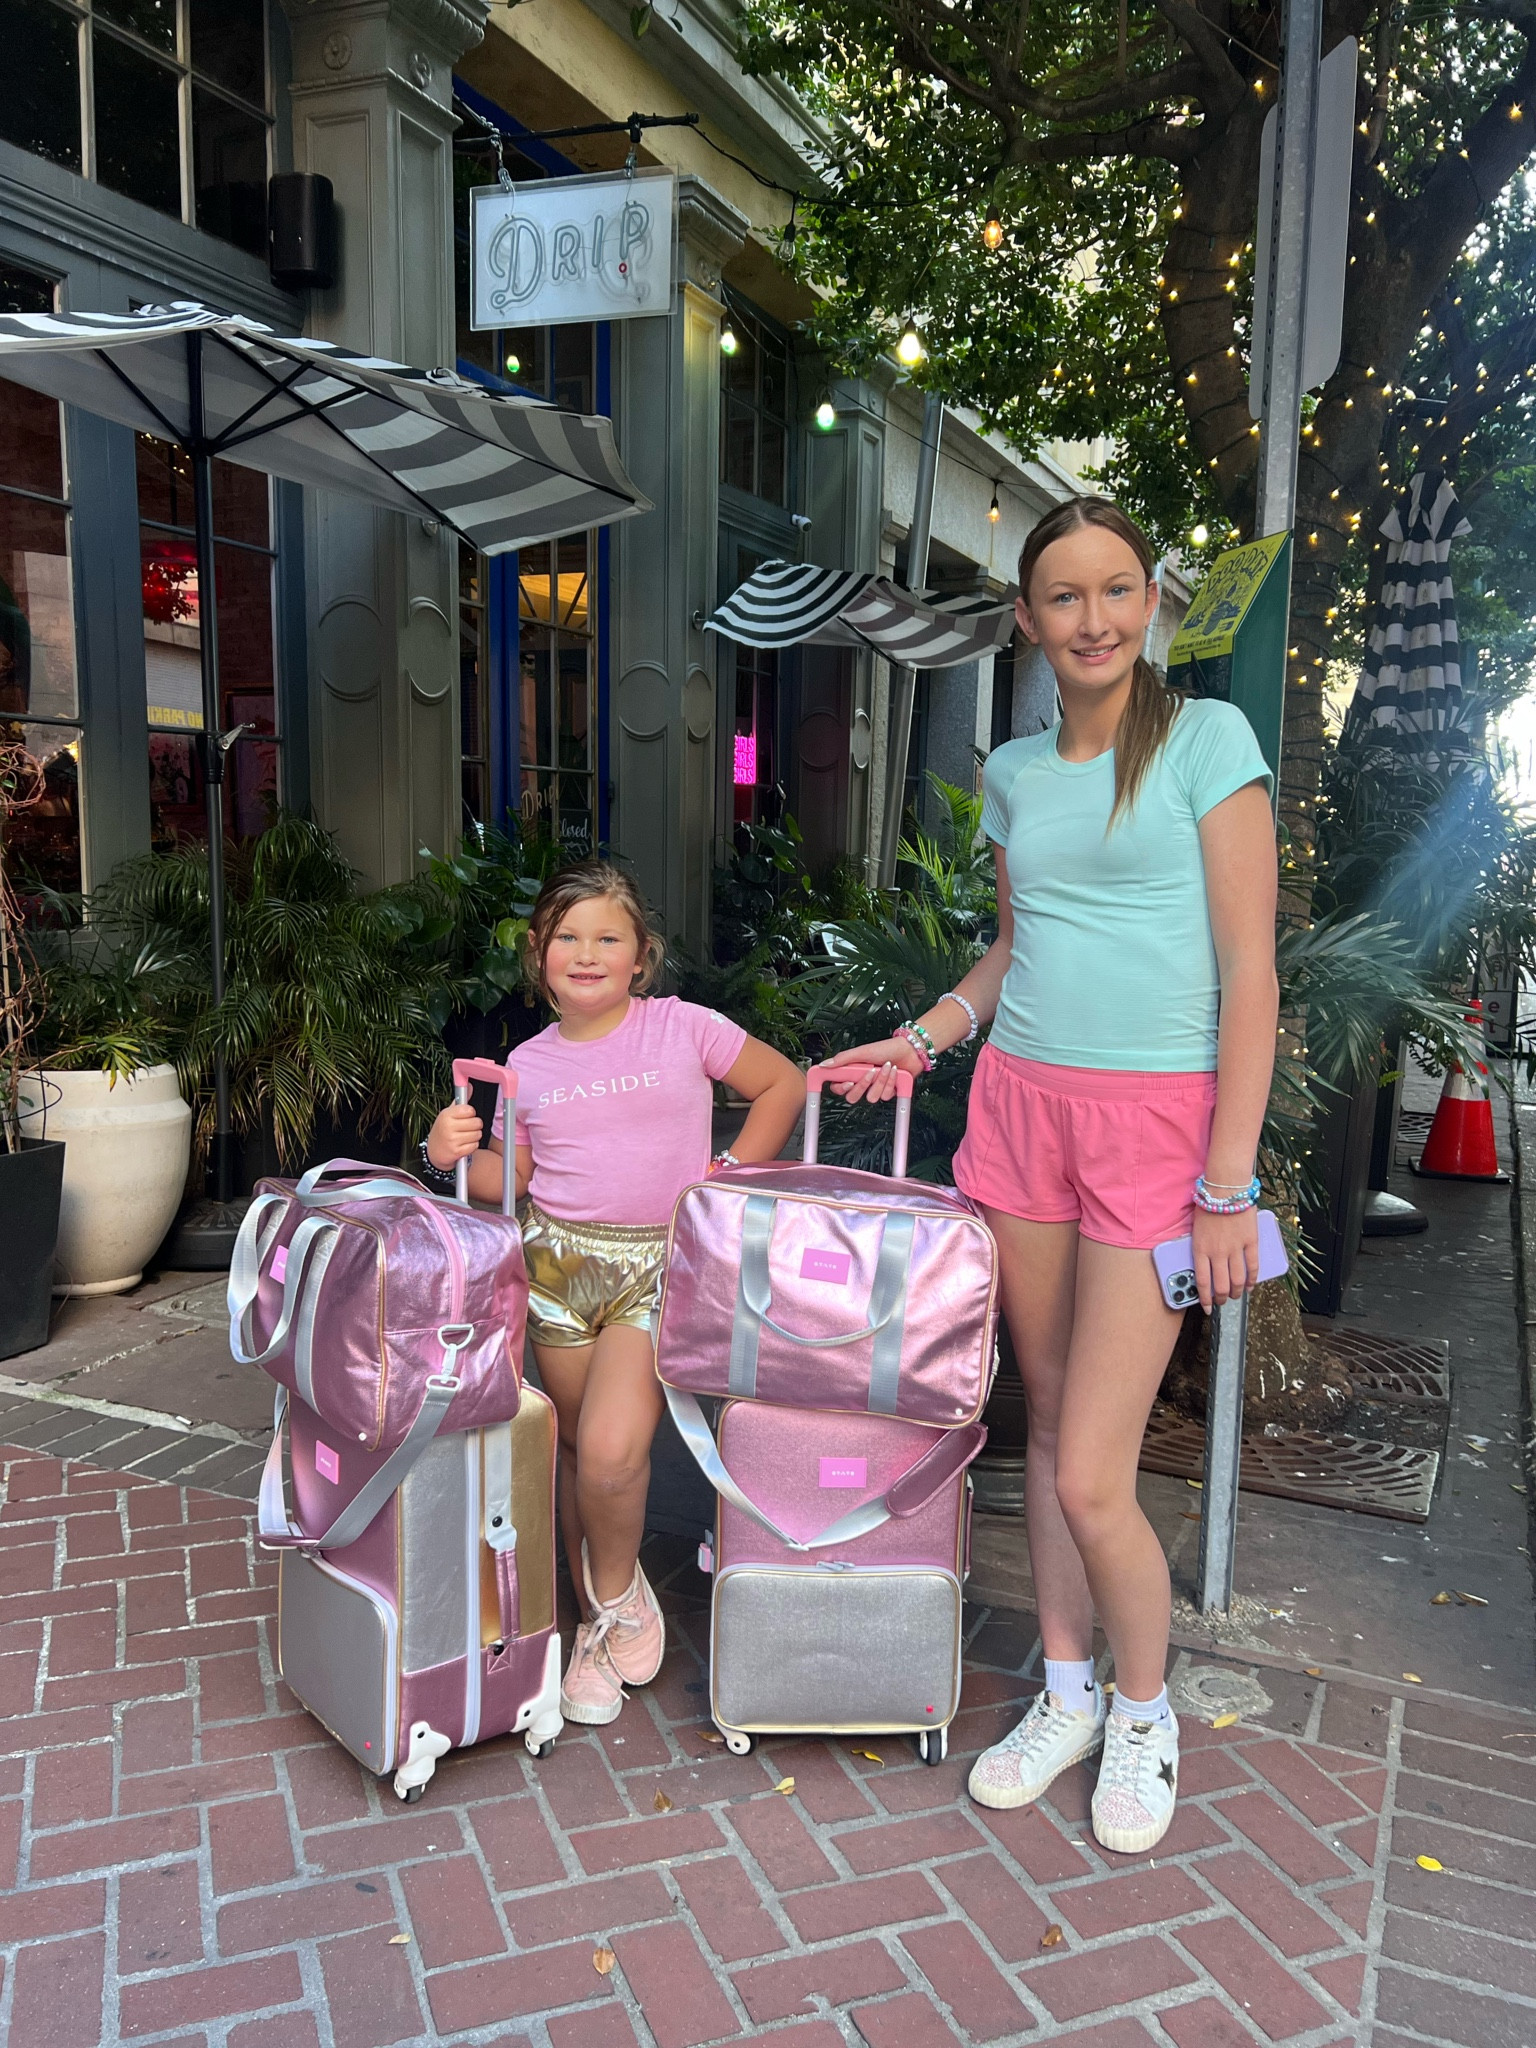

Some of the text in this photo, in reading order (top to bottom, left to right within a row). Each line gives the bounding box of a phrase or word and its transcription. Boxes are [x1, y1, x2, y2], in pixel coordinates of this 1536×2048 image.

[489, 203, 649, 310] DRIP
[560, 818, 590, 840] losed
[538, 1070, 660, 1109] SEASIDE
